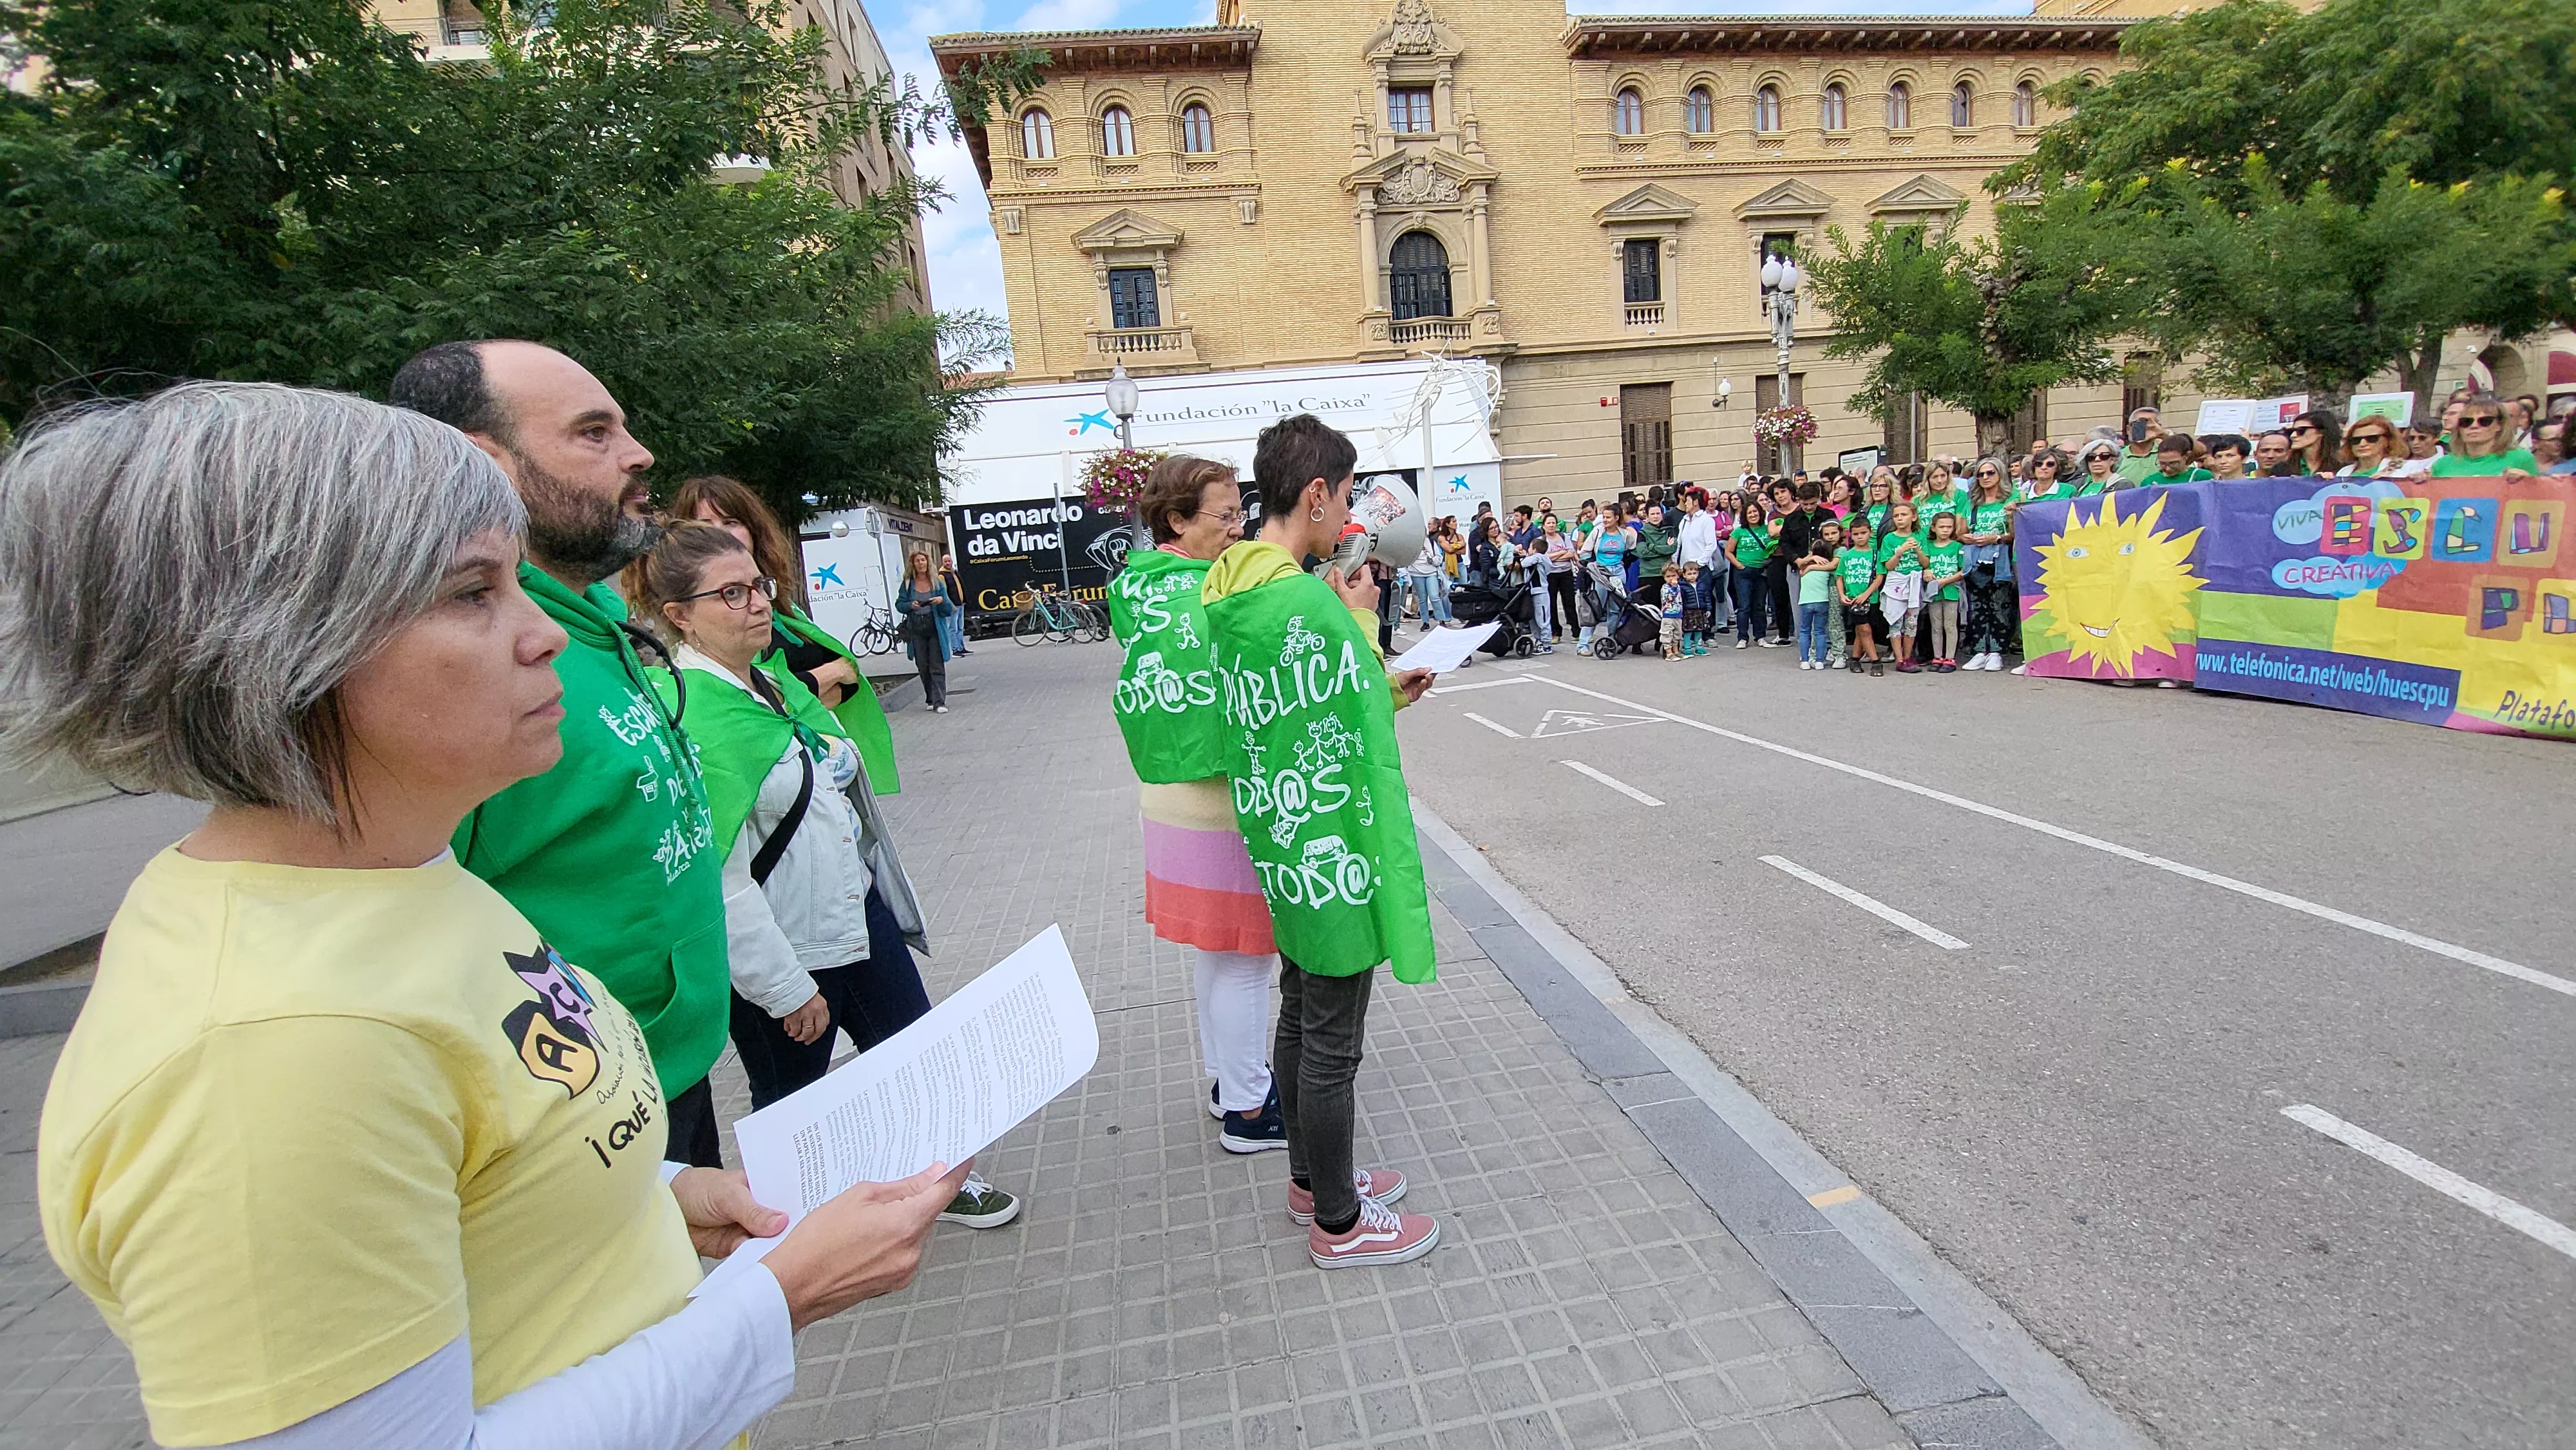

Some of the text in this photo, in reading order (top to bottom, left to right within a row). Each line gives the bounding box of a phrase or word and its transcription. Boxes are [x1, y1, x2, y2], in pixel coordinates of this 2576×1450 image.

[1130, 402, 1258, 423] Fundación
[1298, 393, 1370, 411] Caixa"
[964, 500, 1083, 531] Leonardo
[2277, 510, 2324, 531] VIVA
[967, 528, 1063, 556] da Vinci
[969, 554, 1028, 565] #CaixaForumLeonardo
[2284, 560, 2398, 585] CREATIVA
[2230, 651, 2448, 711] telefonica.net/web/huescpu
[2495, 690, 2576, 730] Platafo
